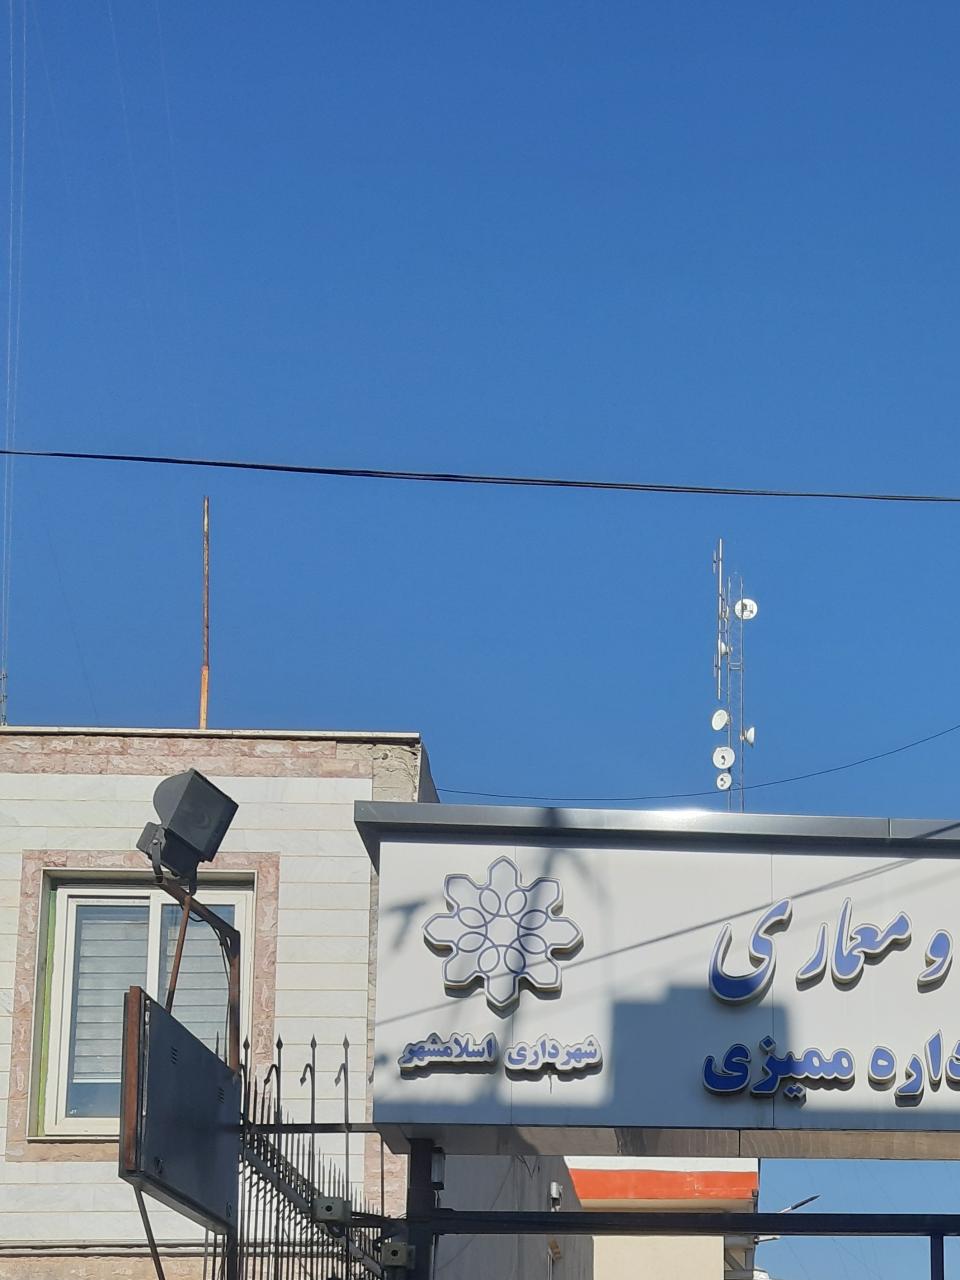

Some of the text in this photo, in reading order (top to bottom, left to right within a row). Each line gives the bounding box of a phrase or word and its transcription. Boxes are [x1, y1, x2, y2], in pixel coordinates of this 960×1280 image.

[708, 896, 913, 1004] معماری
[916, 928, 953, 993] و
[399, 1032, 604, 1084] شهرداری اسلامشهر
[702, 1034, 857, 1106] ممیزی
